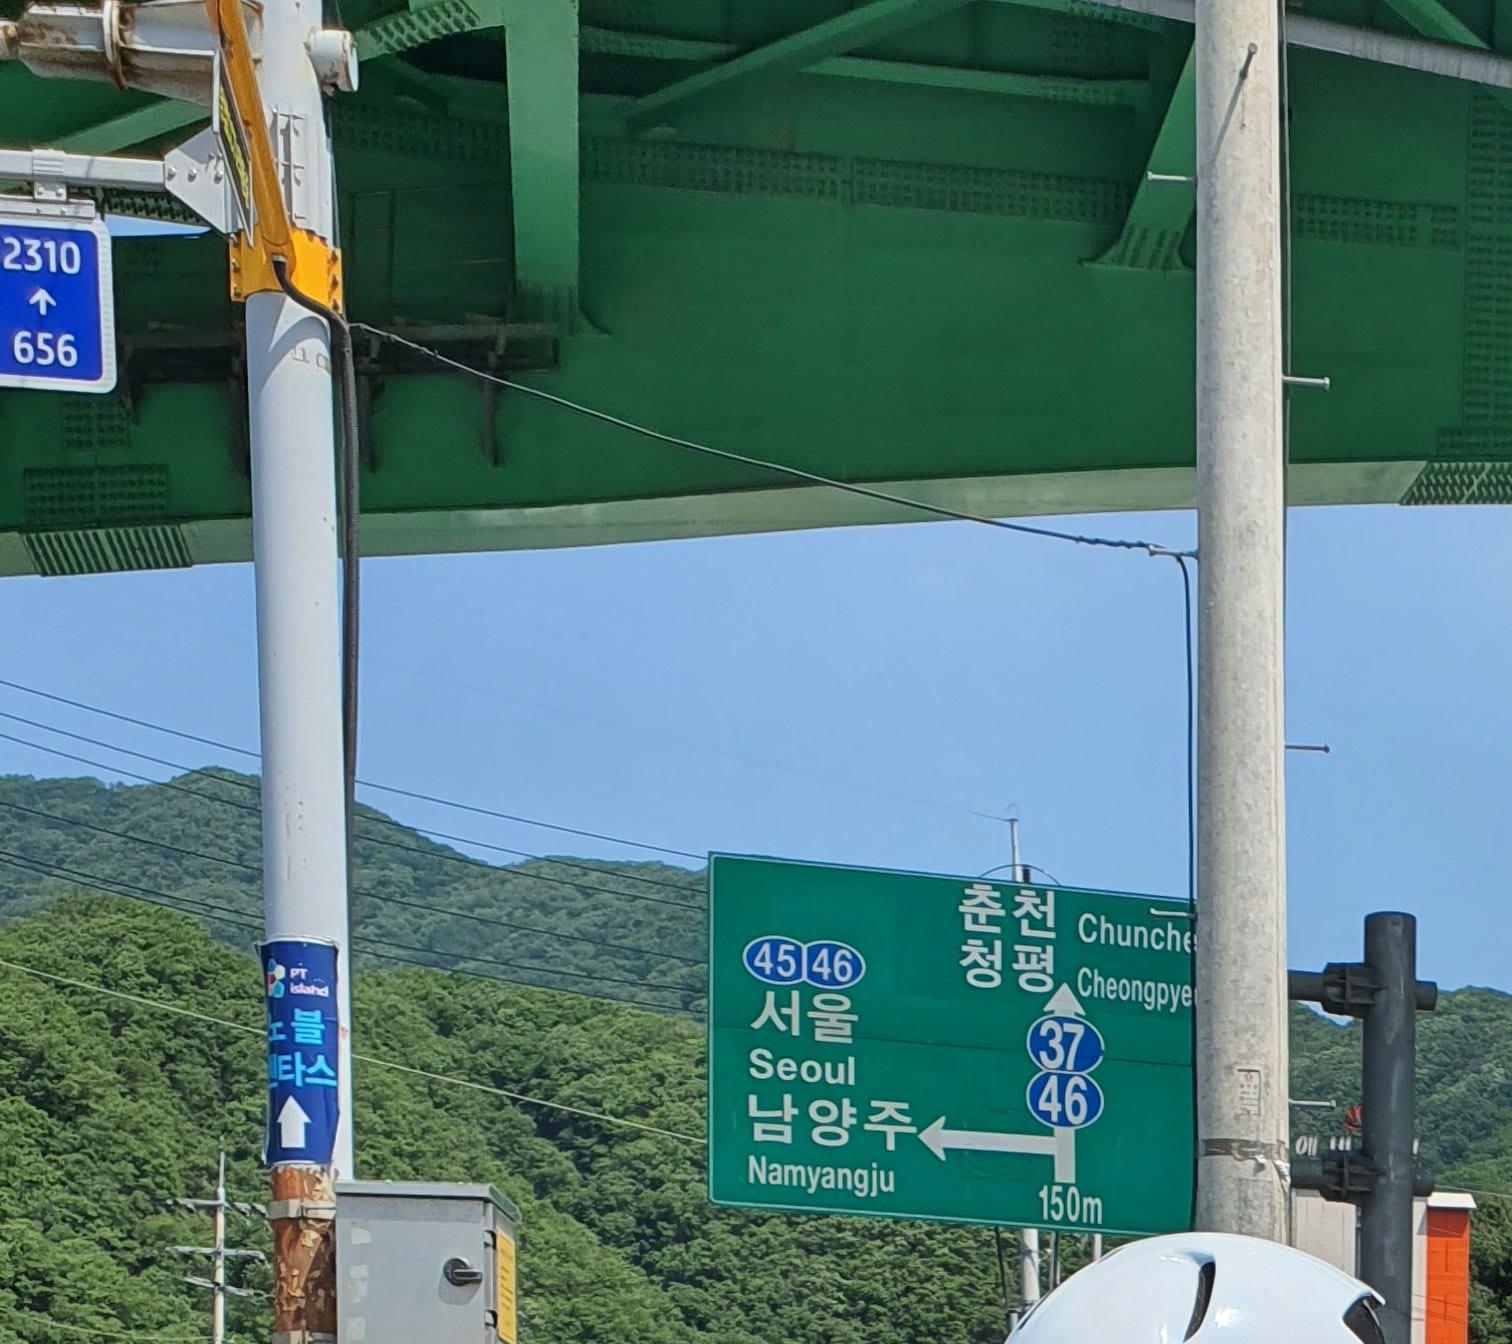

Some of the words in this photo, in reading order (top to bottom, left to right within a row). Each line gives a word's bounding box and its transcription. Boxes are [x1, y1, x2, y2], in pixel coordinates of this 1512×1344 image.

[2, 236, 81, 275] 2310
[13, 329, 79, 368] 656
[957, 883, 1059, 940] 춘천
[1077, 912, 1198, 955] Chunche
[289, 967, 309, 980] PT
[754, 944, 798, 978] 45
[810, 947, 853, 983] 46
[958, 938, 1058, 994] 청평
[1077, 966, 1198, 1014] Cheongpye
[749, 990, 860, 1045] 서울
[1038, 1019, 1087, 1072] 37
[748, 1049, 856, 1086] Seoul
[747, 1092, 918, 1152] 남양주
[1037, 1075, 1088, 1126] 46
[747, 1154, 895, 1196] Namyangju
[1039, 1184, 1103, 1226] 150m
